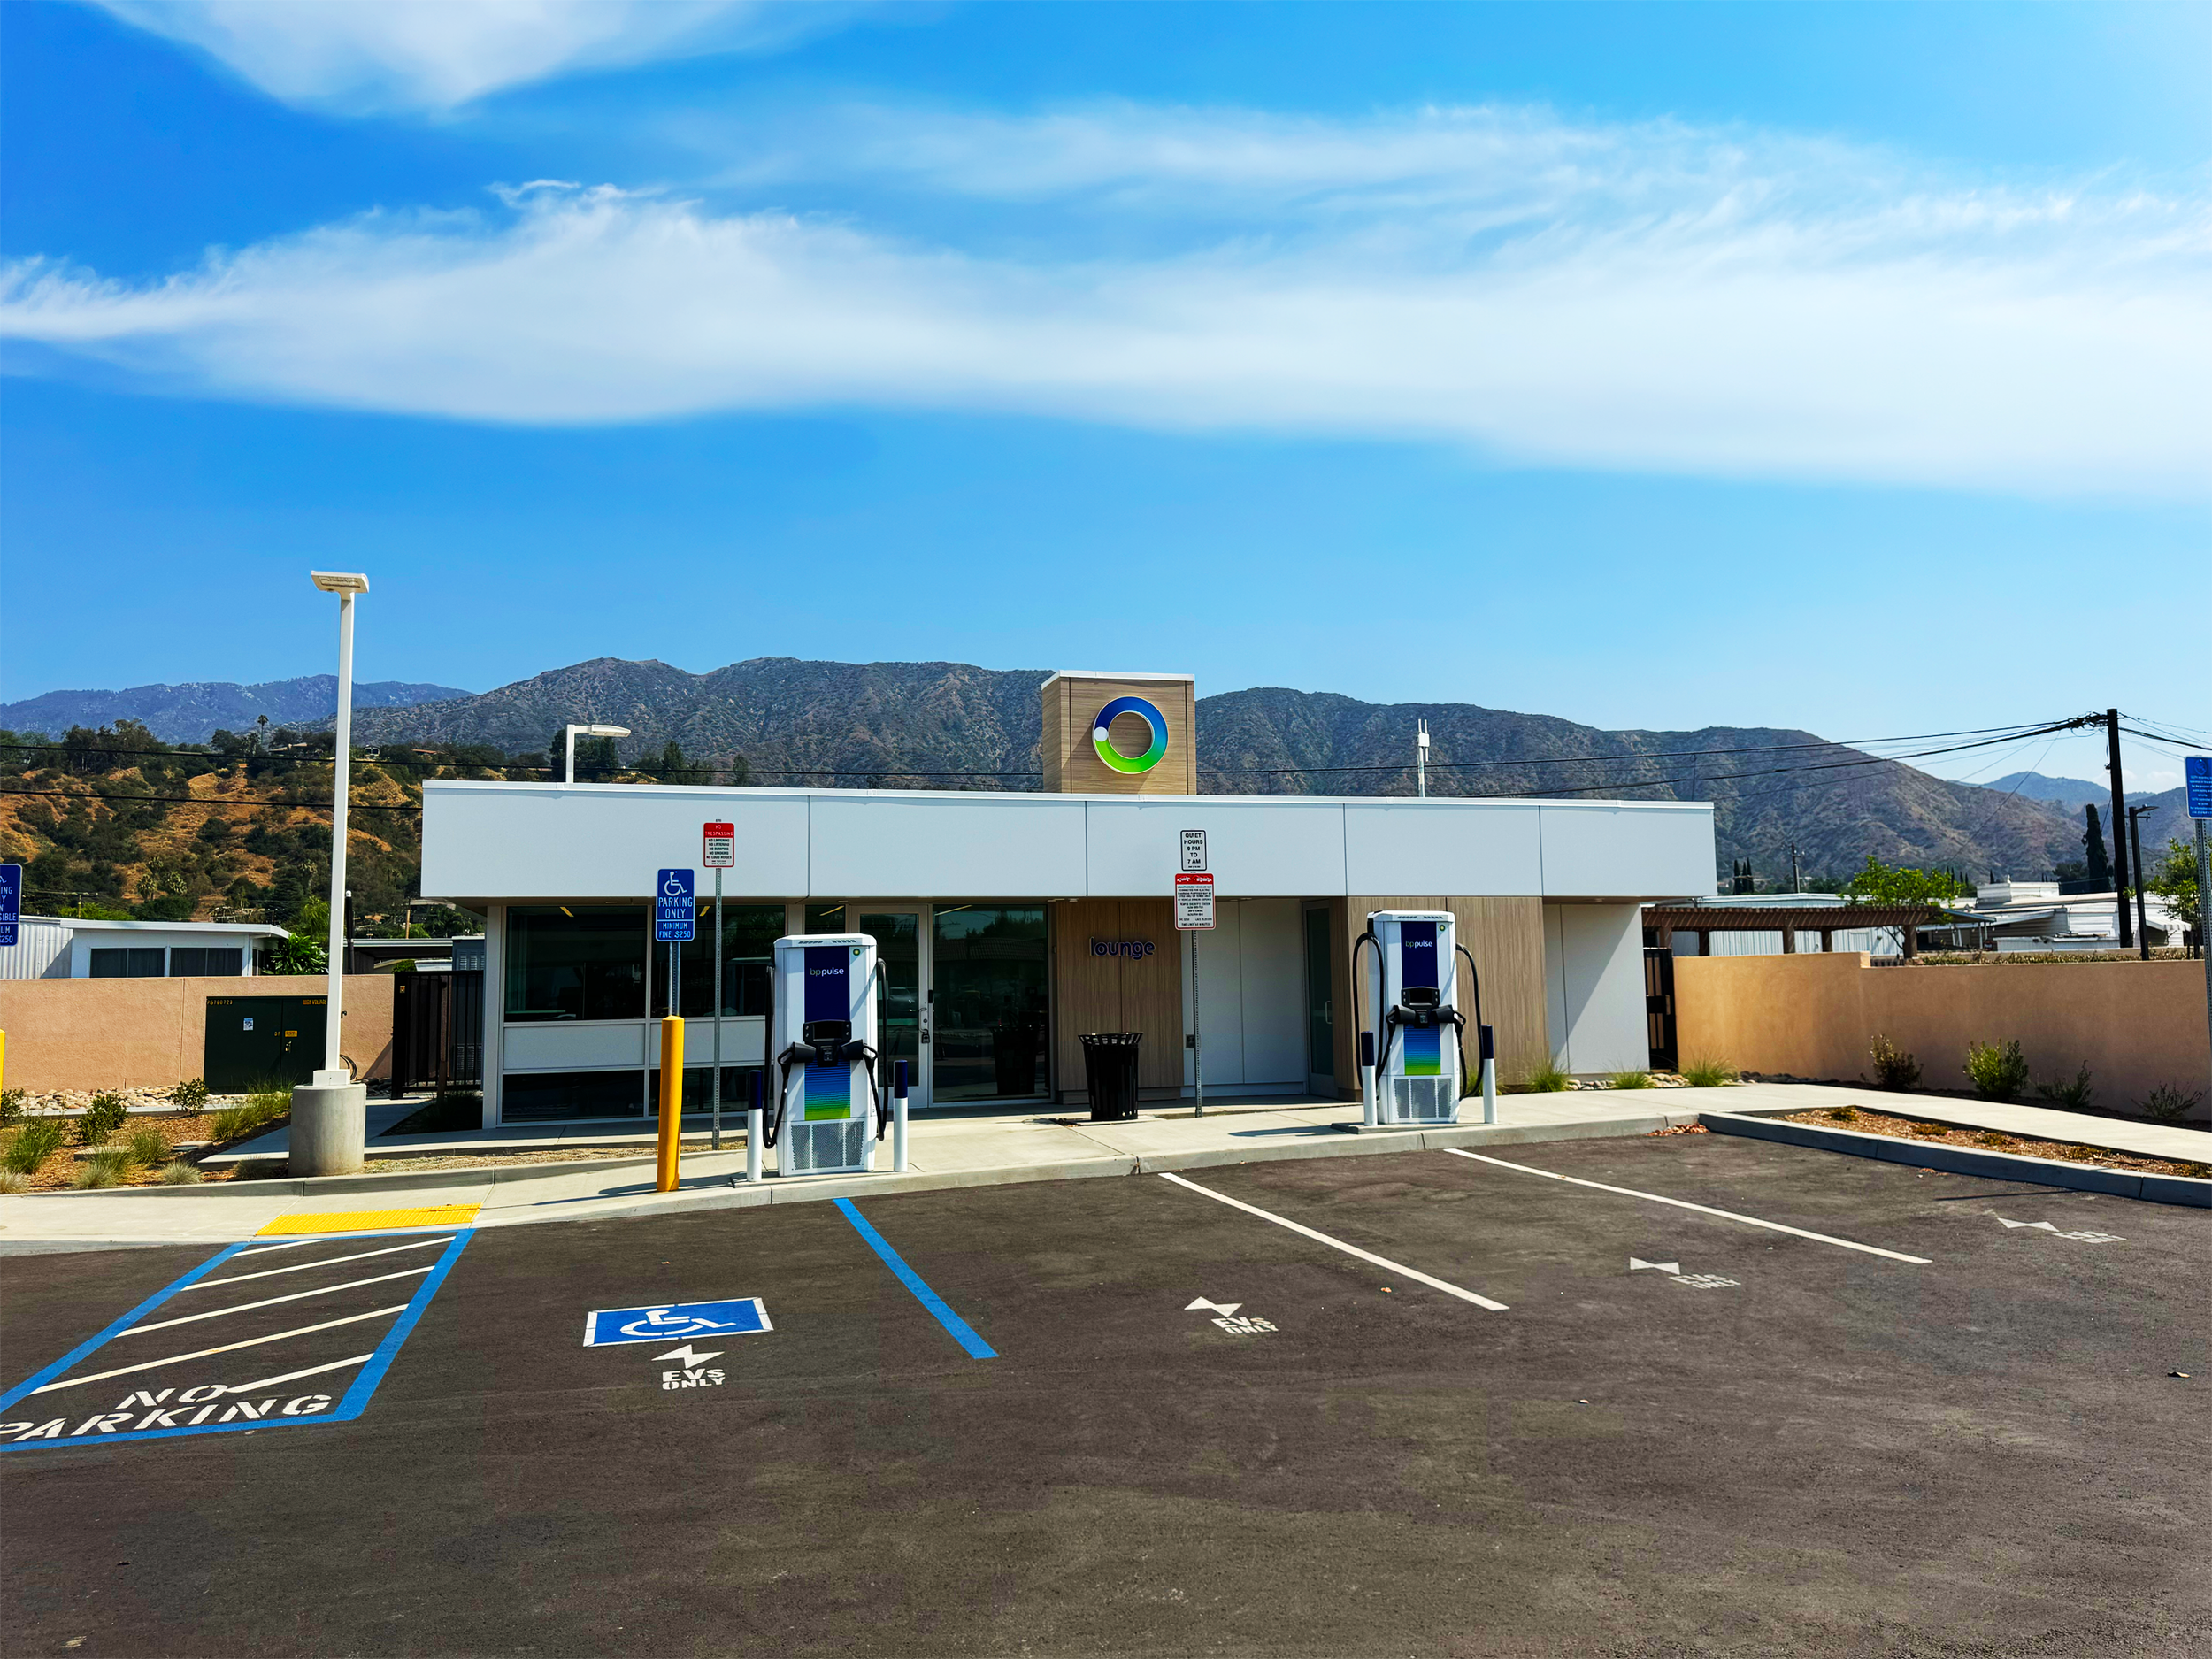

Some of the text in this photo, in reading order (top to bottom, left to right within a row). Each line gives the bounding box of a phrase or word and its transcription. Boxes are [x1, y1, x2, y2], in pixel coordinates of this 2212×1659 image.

[658, 897, 693, 907] PARKING
[665, 908, 686, 918] ONLY
[1090, 937, 1156, 960] lounge
[662, 1377, 726, 1390] ONLY
[115, 1384, 228, 1409] NO
[0, 1394, 333, 1442] PARKING
